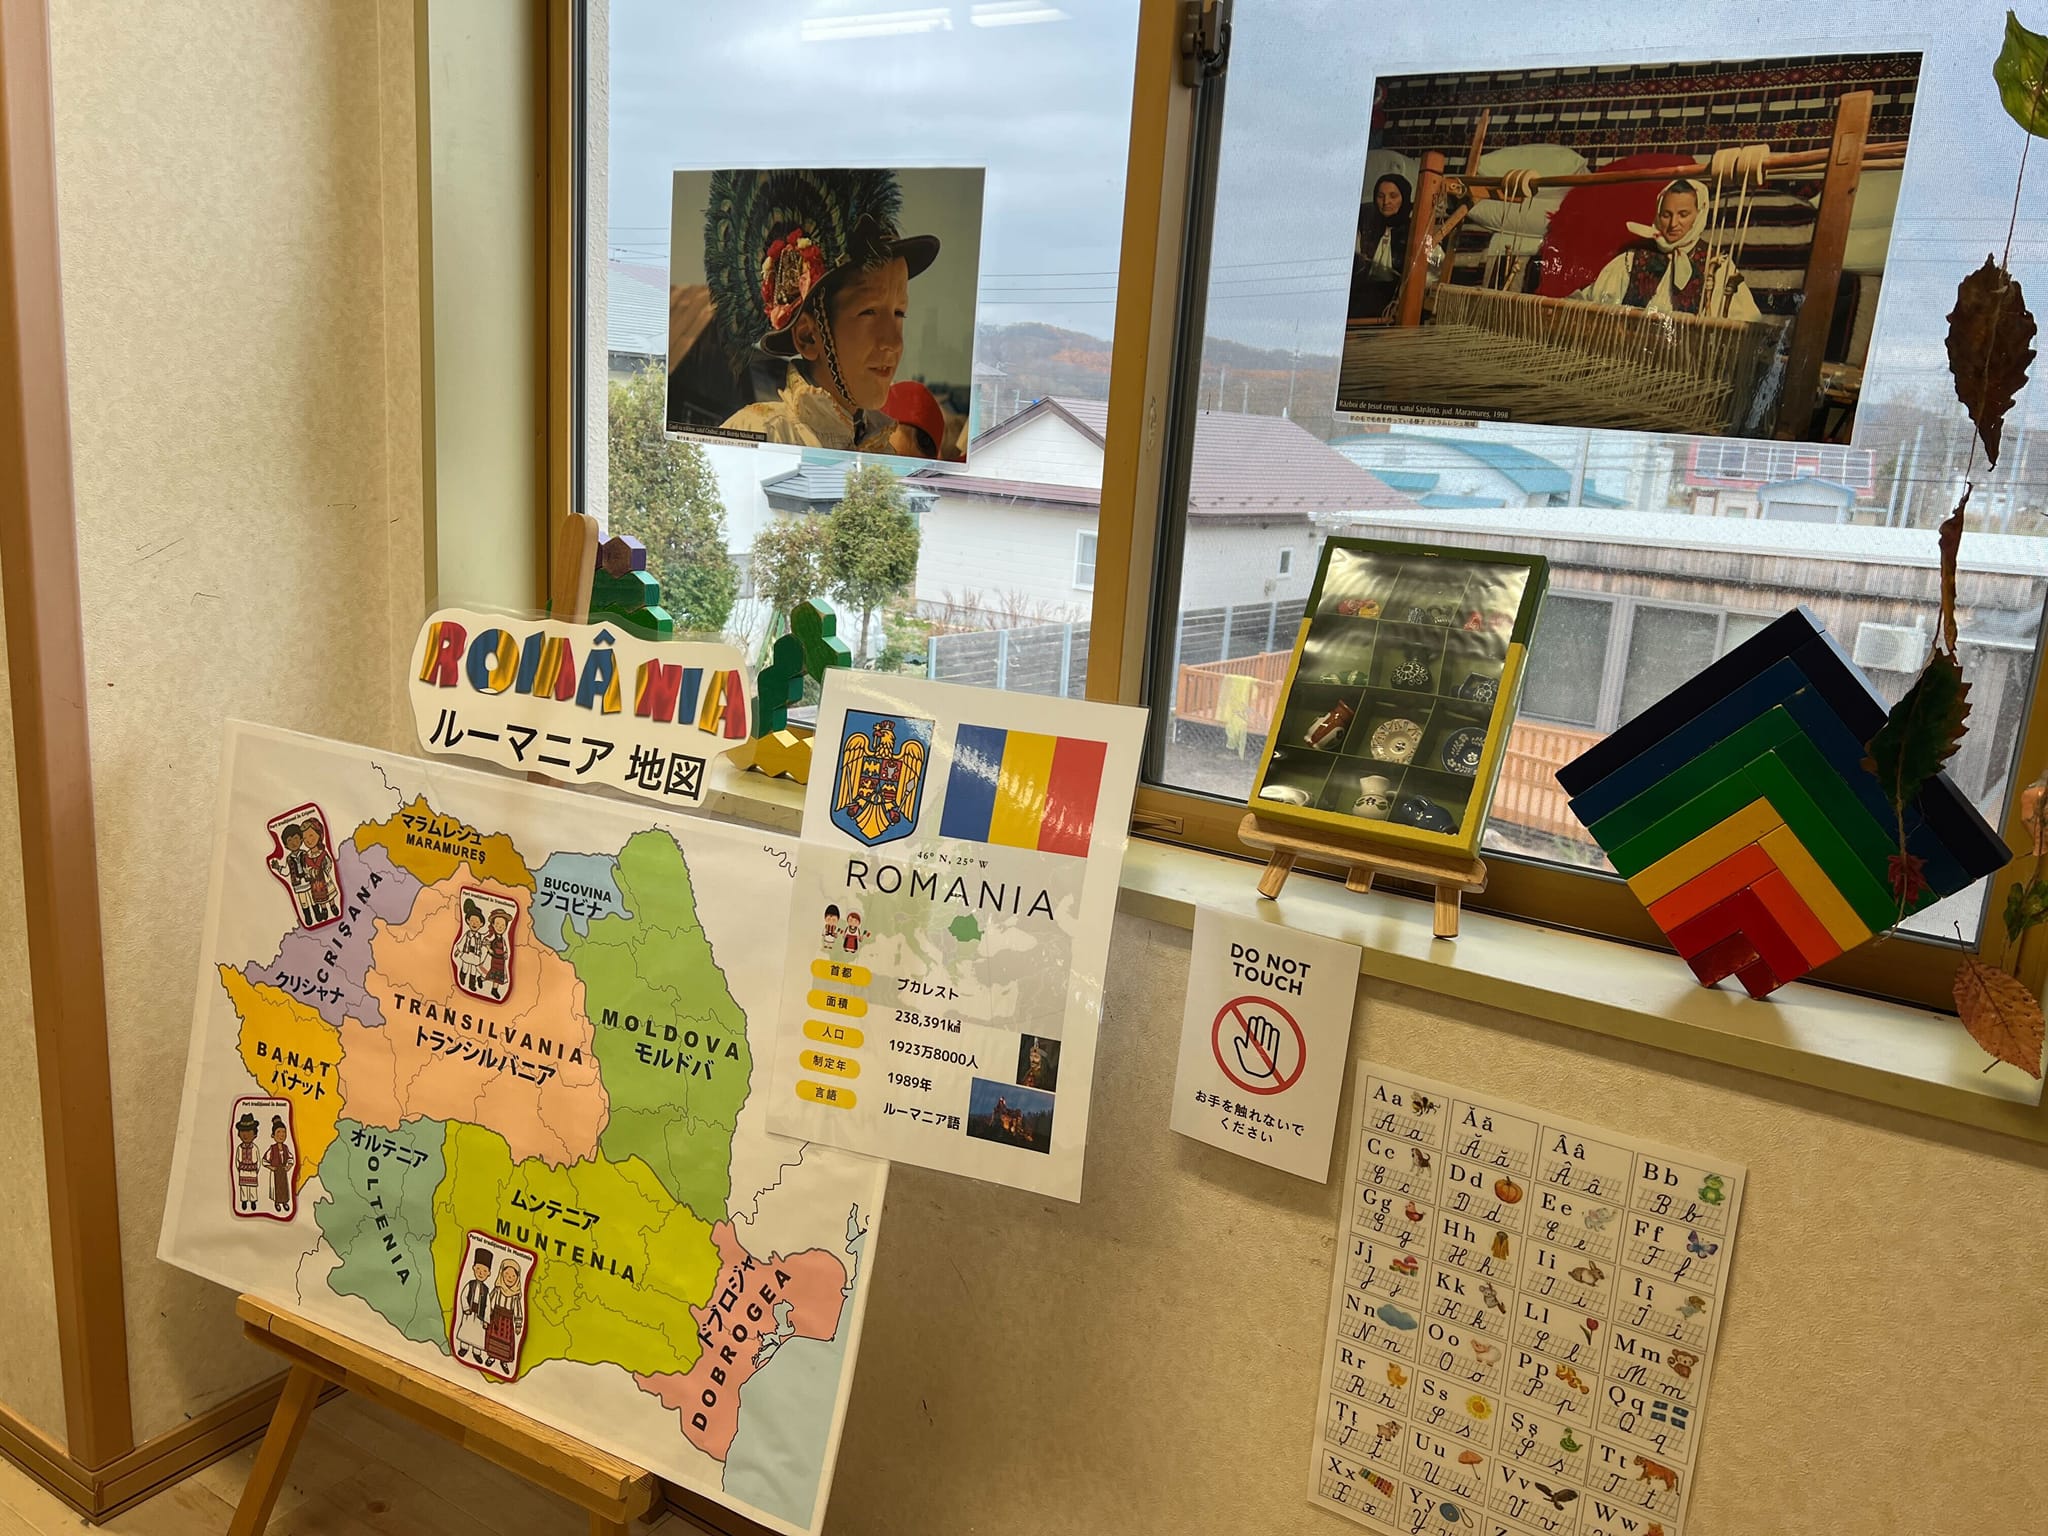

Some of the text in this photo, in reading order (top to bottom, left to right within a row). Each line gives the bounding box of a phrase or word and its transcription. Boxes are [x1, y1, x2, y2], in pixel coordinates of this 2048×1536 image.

[420, 621, 746, 739] ROMÂNIA
[430, 709, 706, 800] ルーマニア 地図
[402, 814, 482, 846] マラムレシュ
[940, 854, 952, 864] N,
[979, 860, 988, 868] W
[544, 877, 612, 902] BUCOVINA
[846, 859, 1054, 920] ROMANIA
[540, 892, 602, 918] ブコビナ
[830, 964, 852, 978] 首都
[1230, 943, 1311, 978] DO NOT
[276, 971, 344, 1005] クリシャナ
[897, 978, 959, 1000] ブカレスト
[1232, 962, 1302, 996] TOUCH
[826, 996, 848, 1010] 面積
[394, 994, 584, 1064] TRANSILVANIA
[602, 1008, 739, 1060] MOLDOVA
[822, 1026, 844, 1040] 人口
[257, 1041, 330, 1077] BANAT
[416, 1026, 556, 1086] トランシルバニア
[635, 1042, 714, 1080] モルドバ
[813, 1055, 846, 1071] 制定年
[889, 1040, 979, 1069] 1923万8000人
[272, 1072, 326, 1100] バナット
[815, 1087, 838, 1100] 言語
[888, 1072, 932, 1092] 1989年
[1373, 1085, 1402, 1107] A a
[883, 1102, 960, 1130] ルーマニア語
[1195, 1090, 1304, 1136] お手を触れないで
[1462, 1106, 1493, 1132] Ă ă
[1220, 1118, 1273, 1142] ください
[351, 1129, 428, 1168] オルテニア
[1368, 1138, 1394, 1160] C c
[1552, 1134, 1586, 1160] Â â
[1450, 1164, 1482, 1188] D d
[1642, 1162, 1678, 1186] B b
[511, 1190, 600, 1230] ムンテニア
[1363, 1188, 1392, 1214] G g
[1541, 1192, 1572, 1216] E e
[367, 1156, 410, 1285] OLTENIA
[1443, 1219, 1476, 1244] H h
[1634, 1219, 1664, 1242] F f
[496, 1218, 634, 1282] MUNTENIA
[1355, 1241, 1372, 1264] J j
[1537, 1249, 1556, 1270] I i
[1436, 1272, 1466, 1296] K k
[1634, 1278, 1654, 1301] Î î
[698, 1256, 756, 1348] ドブロジャ
[1346, 1294, 1375, 1318] N n
[1524, 1302, 1548, 1324] L l
[1428, 1324, 1459, 1346] O o
[692, 1269, 792, 1431] DOBROGEA
[1341, 1348, 1366, 1370] R r
[1614, 1334, 1661, 1364] M m
[1518, 1352, 1548, 1379] P p
[1422, 1378, 1448, 1400] S s
[1608, 1386, 1644, 1416] Q q
[1416, 1432, 1446, 1458] U u
[1600, 1444, 1627, 1469] T t
[1328, 1456, 1356, 1481] X x
[1501, 1466, 1530, 1490] V v
[1410, 1487, 1436, 1514] Y y
[1595, 1502, 1638, 1532] W w
